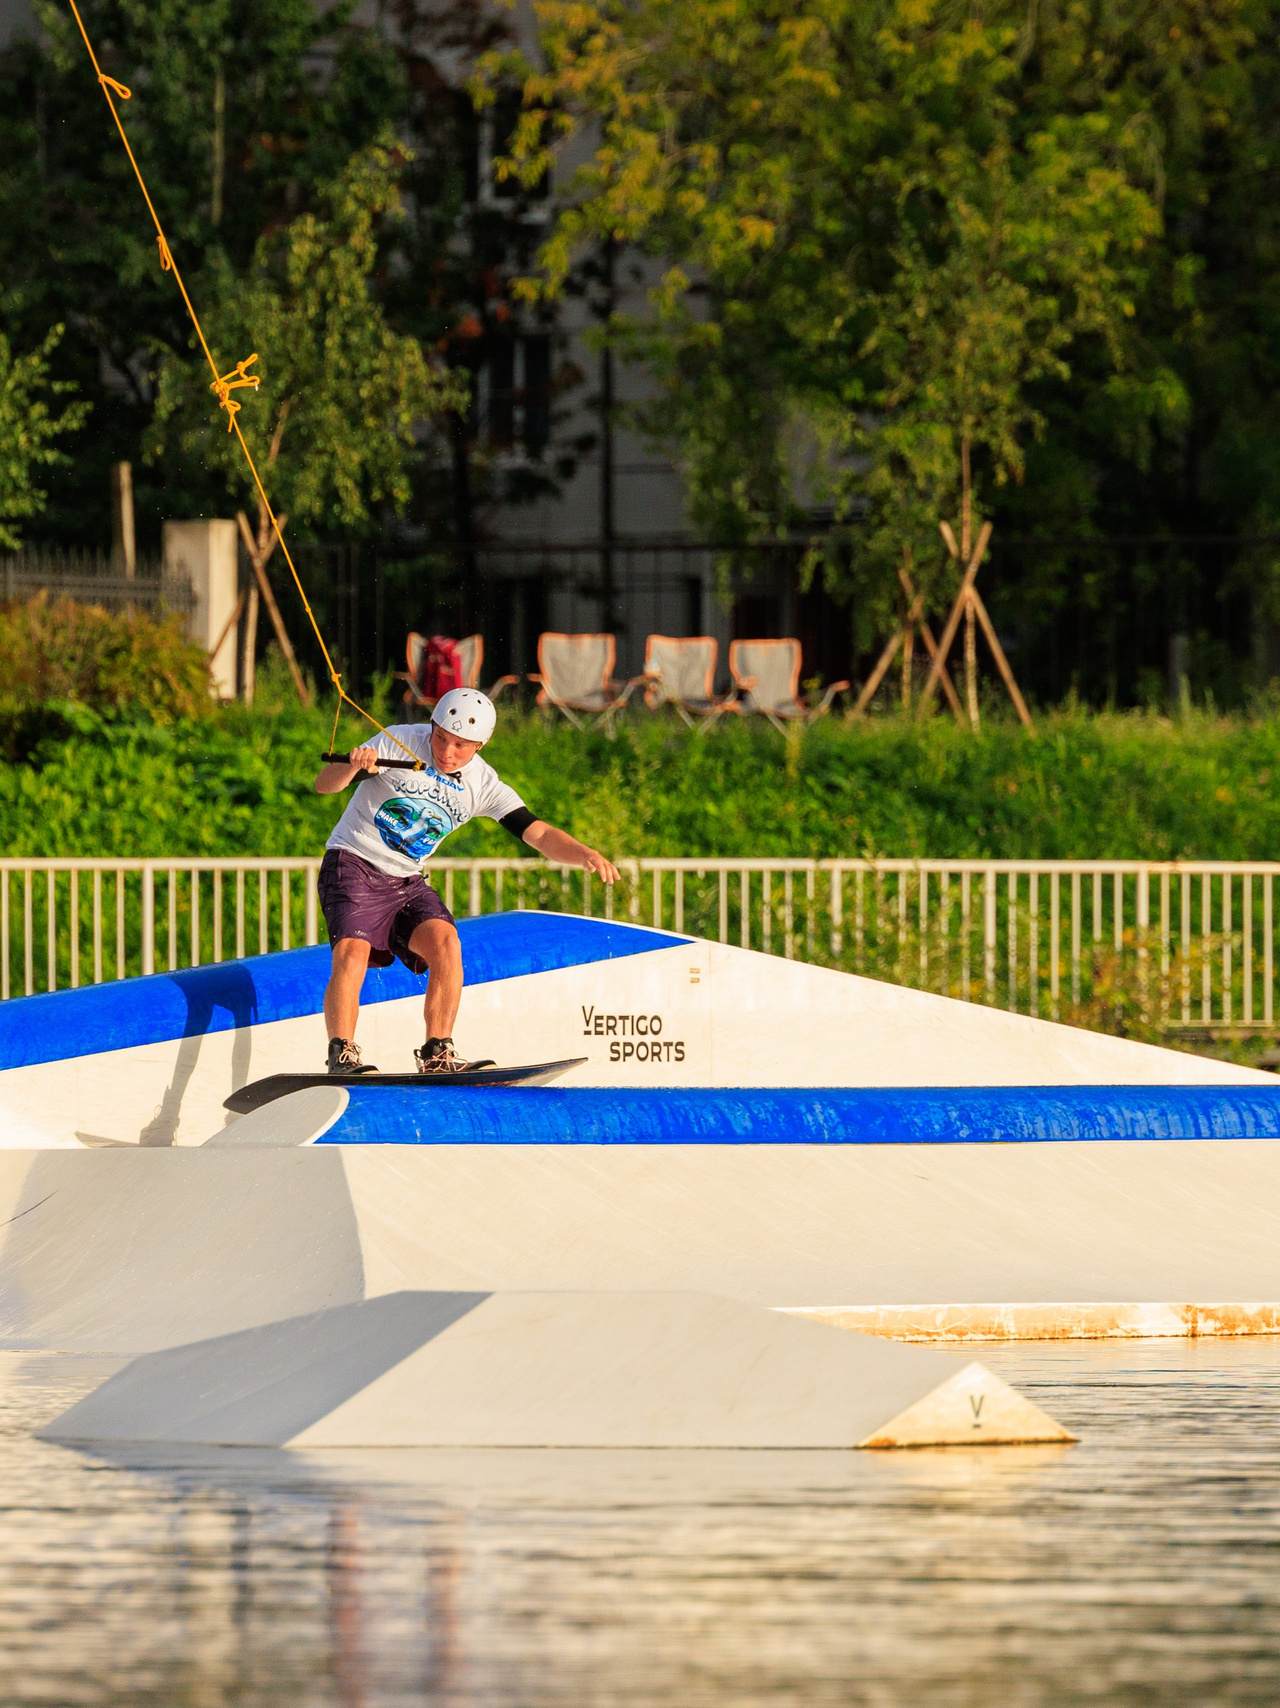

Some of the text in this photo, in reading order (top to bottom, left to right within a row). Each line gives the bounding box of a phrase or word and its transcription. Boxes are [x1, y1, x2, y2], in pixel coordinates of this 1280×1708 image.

[378, 809, 399, 826] WAKE
[582, 1005, 662, 1036] VERTIGO
[609, 1041, 686, 1062] SPORTS
